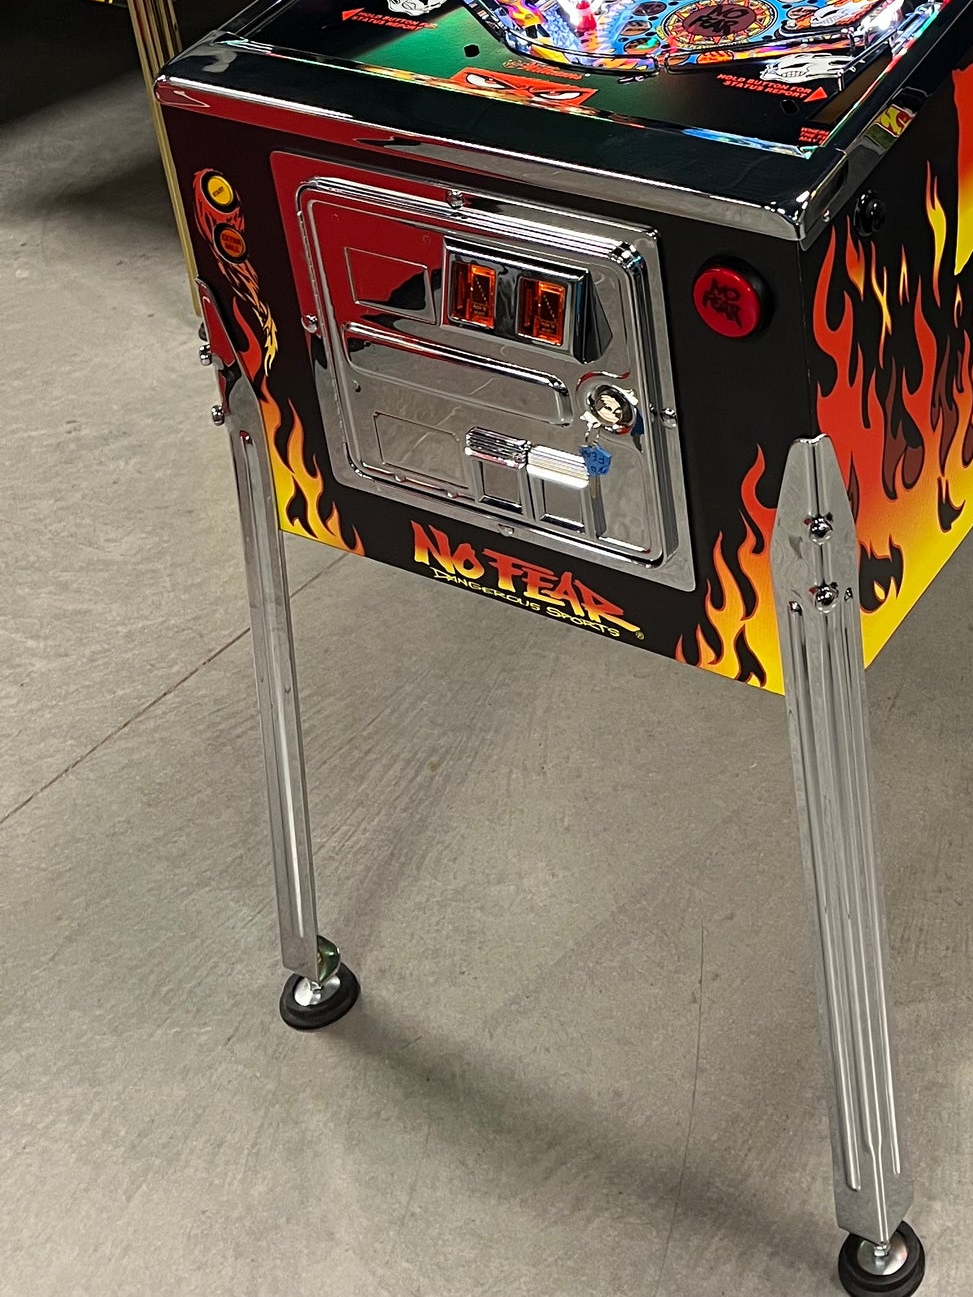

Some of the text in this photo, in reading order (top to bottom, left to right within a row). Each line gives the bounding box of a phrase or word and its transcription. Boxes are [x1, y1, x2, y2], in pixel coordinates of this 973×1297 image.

[705, 4, 747, 19] NO
[689, 13, 738, 36] FEAR
[717, 74, 812, 94] HOLD BUTTON FOR
[723, 81, 808, 98] STATUS REPORT
[702, 278, 742, 308] NO
[410, 519, 641, 633] NO FEAR
[430, 566, 620, 638] DANGEROUS SPORTS
